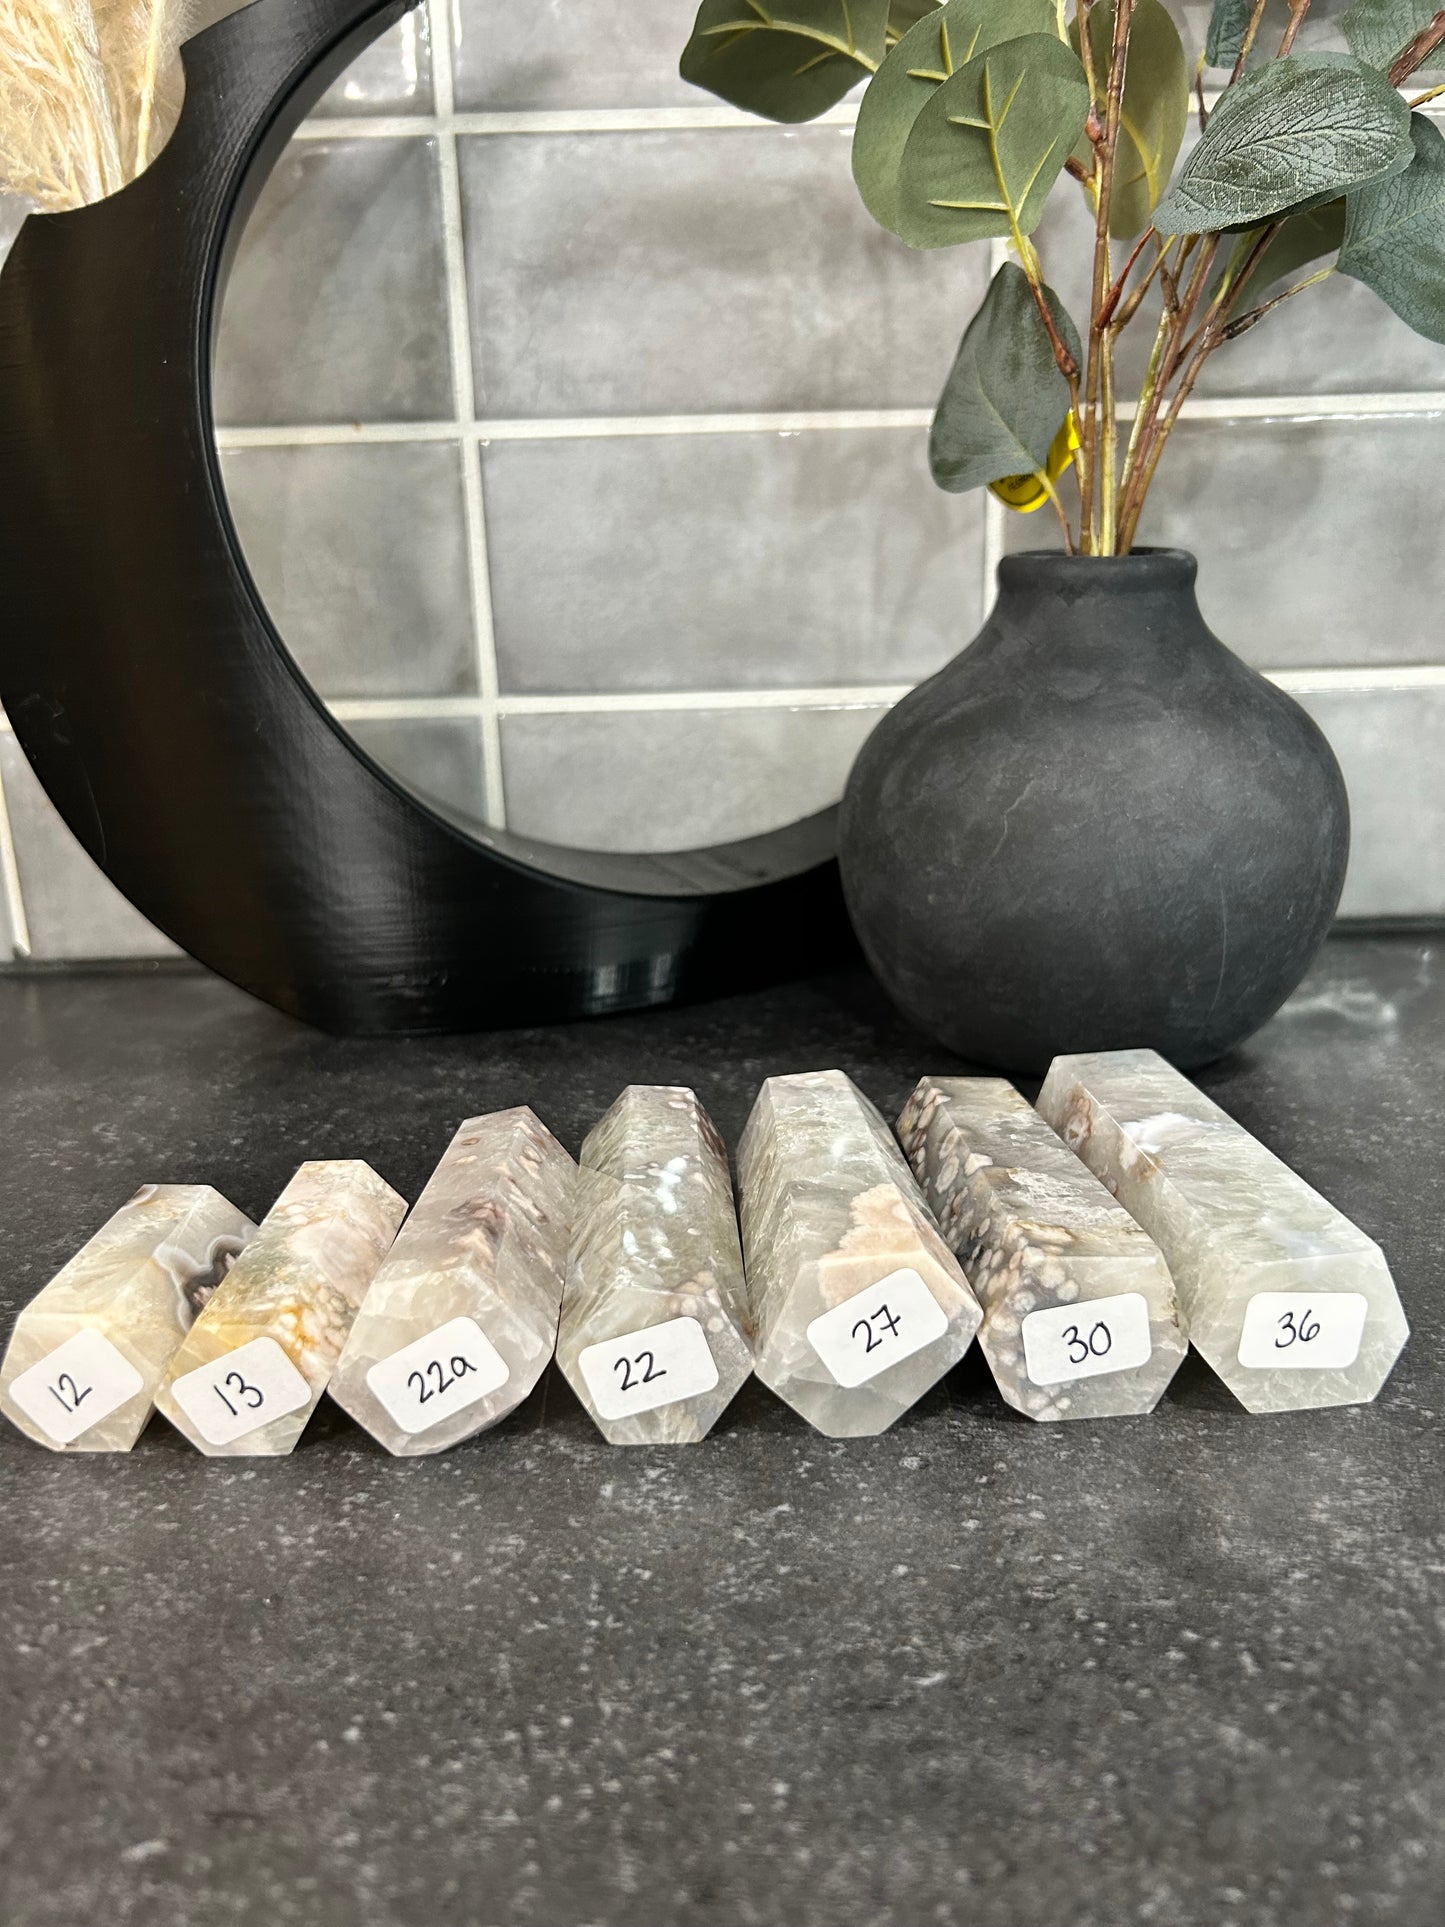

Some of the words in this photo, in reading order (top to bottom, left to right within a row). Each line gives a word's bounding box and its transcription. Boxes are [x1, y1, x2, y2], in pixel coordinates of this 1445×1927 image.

[852, 1304, 902, 1353] 27
[1062, 1321, 1113, 1364] 30
[1275, 1309, 1322, 1348] 36
[47, 1372, 93, 1412] 12
[407, 1356, 478, 1404] 22a
[613, 1351, 668, 1391] 22
[214, 1372, 264, 1416] 13
